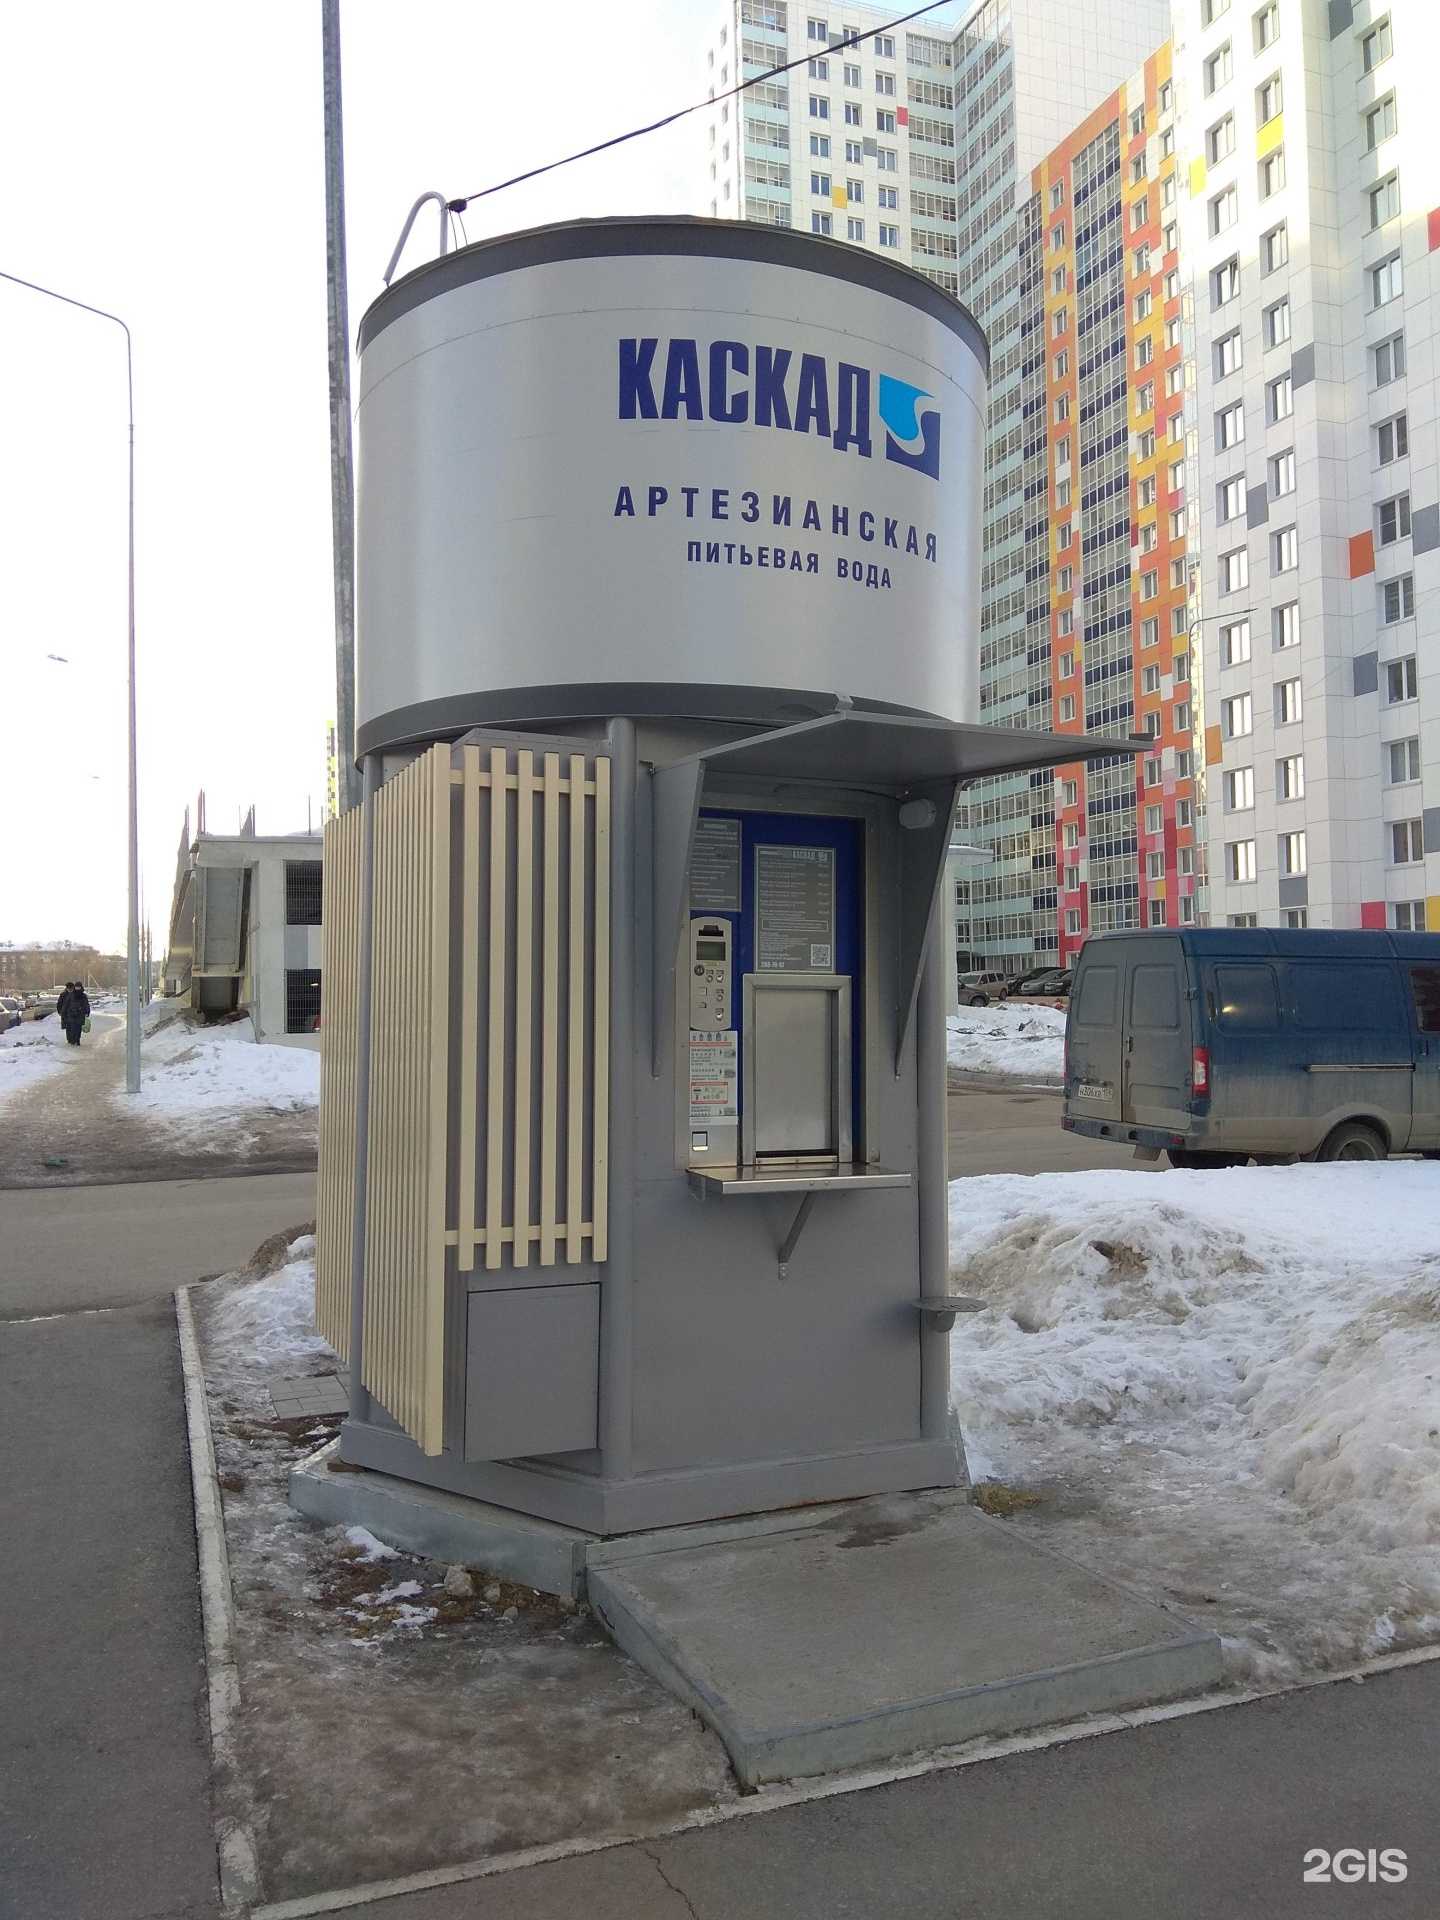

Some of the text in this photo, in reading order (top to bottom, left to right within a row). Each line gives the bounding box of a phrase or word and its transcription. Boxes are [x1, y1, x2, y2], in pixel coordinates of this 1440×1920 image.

[618, 338, 872, 458] КАСКАД
[614, 485, 937, 563] АРТЕЗИАНСКАЯ
[687, 541, 892, 589] ПИТЬЕВАЯ ВОДА
